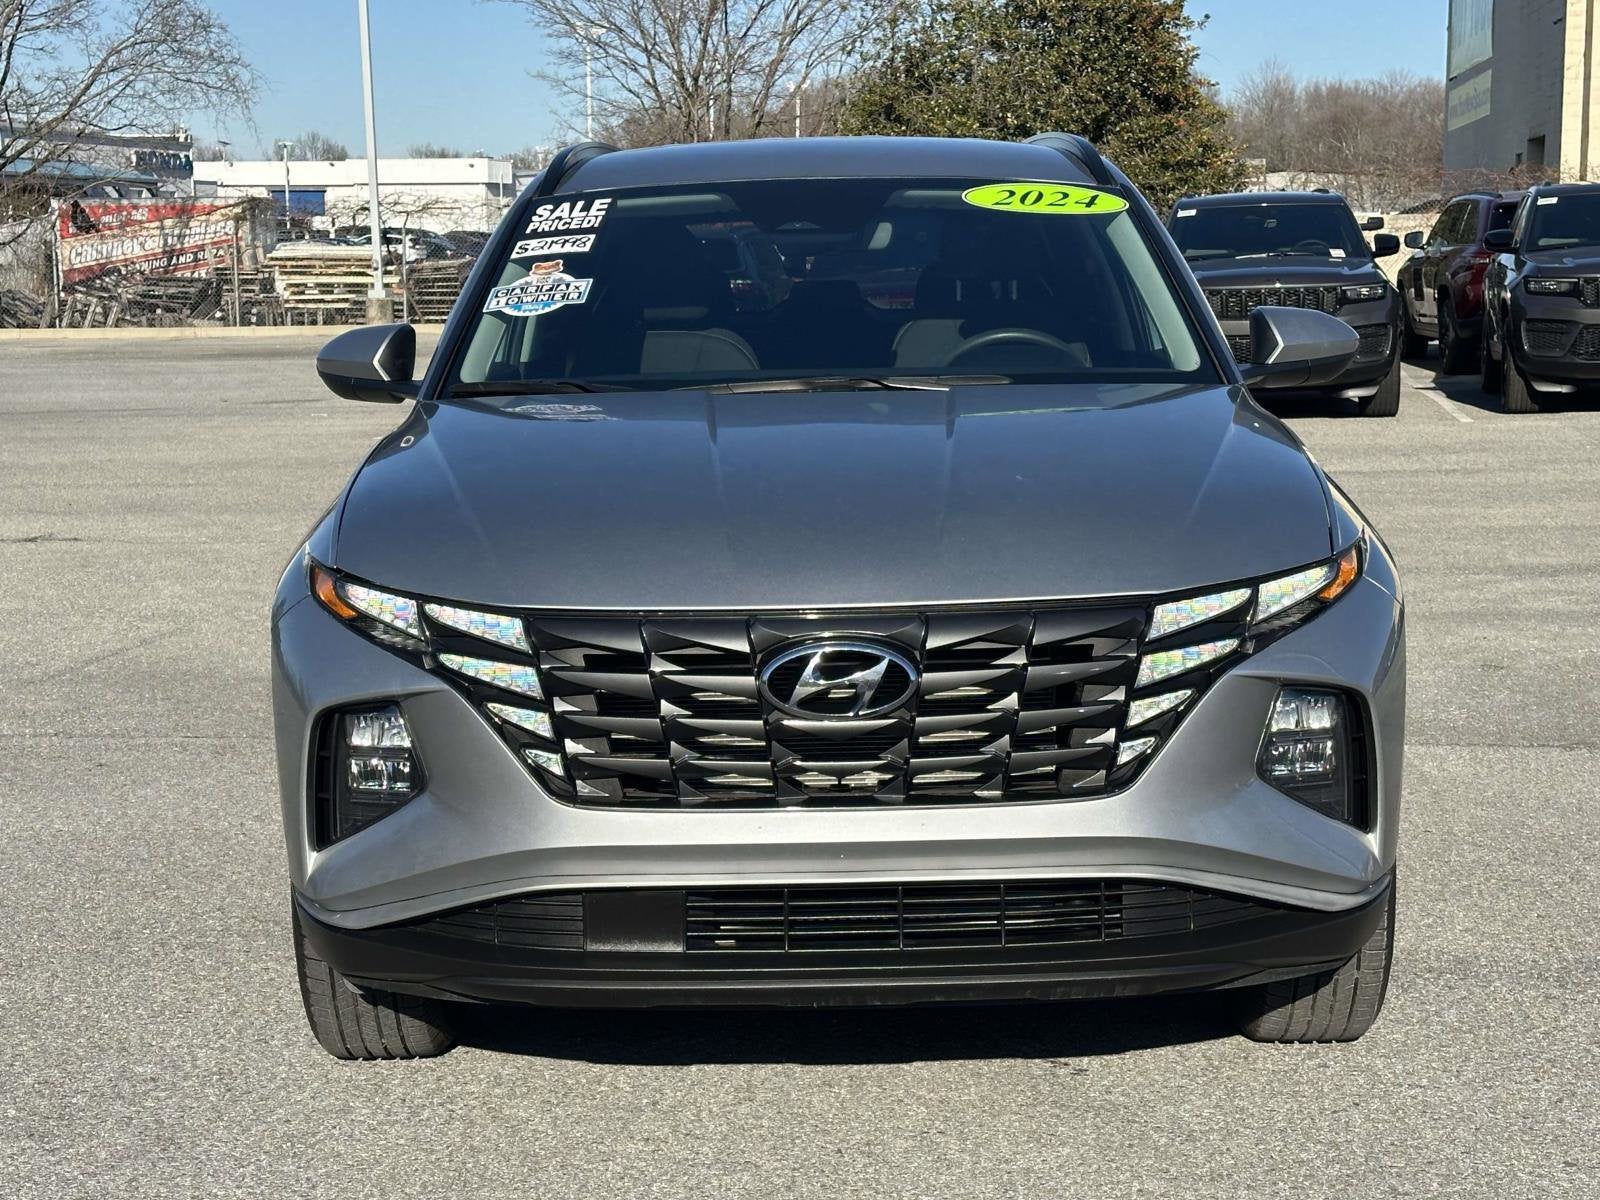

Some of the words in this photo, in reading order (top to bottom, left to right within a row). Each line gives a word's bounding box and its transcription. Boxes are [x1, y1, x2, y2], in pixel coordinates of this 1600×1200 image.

[992, 189, 1100, 208] 2024
[531, 198, 612, 222] SALE
[525, 215, 603, 234] PRICED!
[170, 253, 194, 266] AND
[497, 283, 583, 298] CARFAX
[507, 292, 580, 305] OWNER
